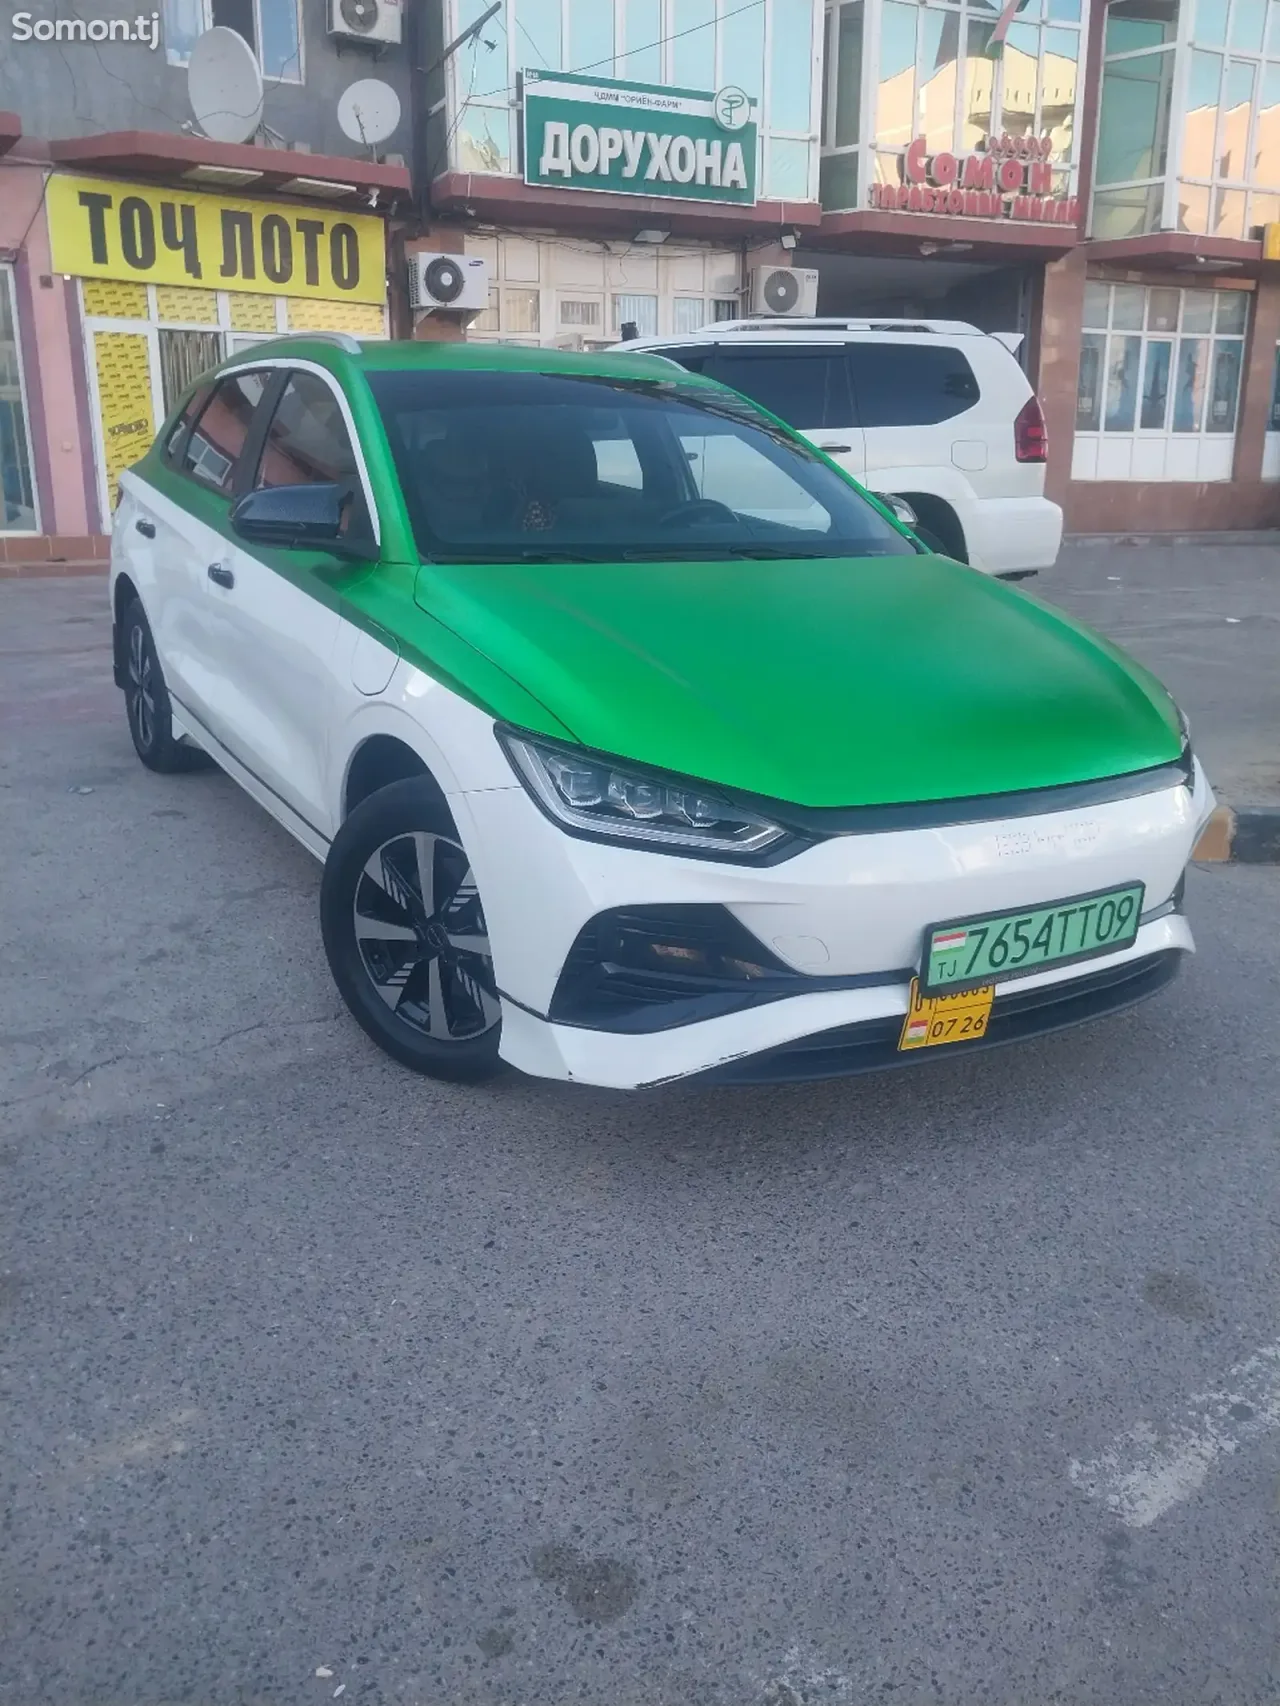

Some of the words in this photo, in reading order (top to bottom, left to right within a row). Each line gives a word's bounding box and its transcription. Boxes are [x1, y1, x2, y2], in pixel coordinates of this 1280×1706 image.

[539, 121, 747, 188] ДОРУХОНА
[220, 208, 360, 290] ЛОТО
[964, 895, 1134, 976] 7654TT09
[938, 960, 957, 979] TJ
[932, 1018, 958, 1038] 07
[960, 1014, 986, 1034] 26
